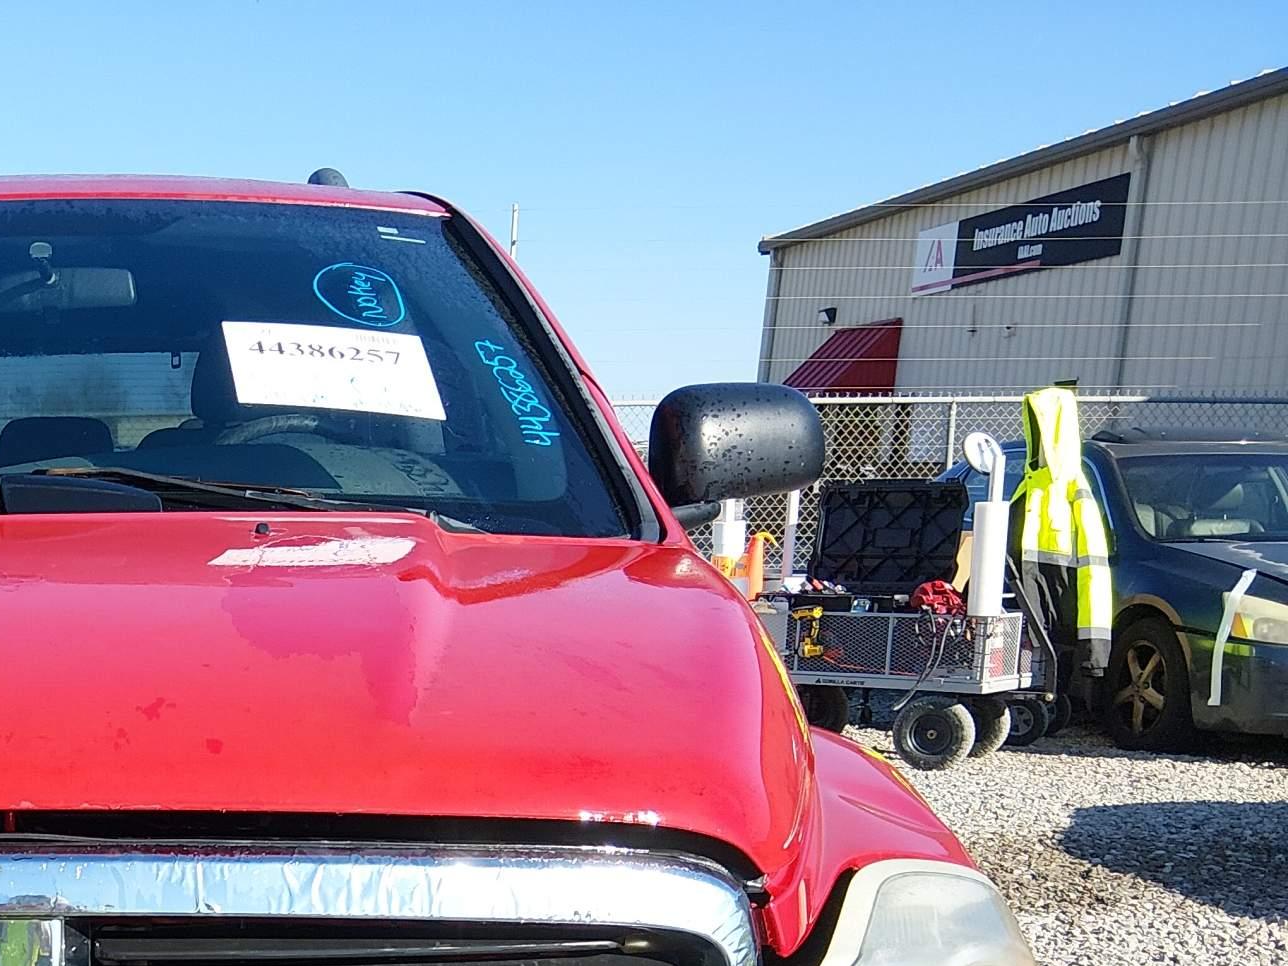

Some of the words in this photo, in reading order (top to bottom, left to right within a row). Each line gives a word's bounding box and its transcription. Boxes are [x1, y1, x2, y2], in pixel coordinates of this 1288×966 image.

[972, 221, 1024, 251] Insurance
[1024, 213, 1048, 239] Auto
[1049, 199, 1101, 232] Auctions
[248, 340, 400, 365] 44386257
[474, 340, 560, 446] 44386257
